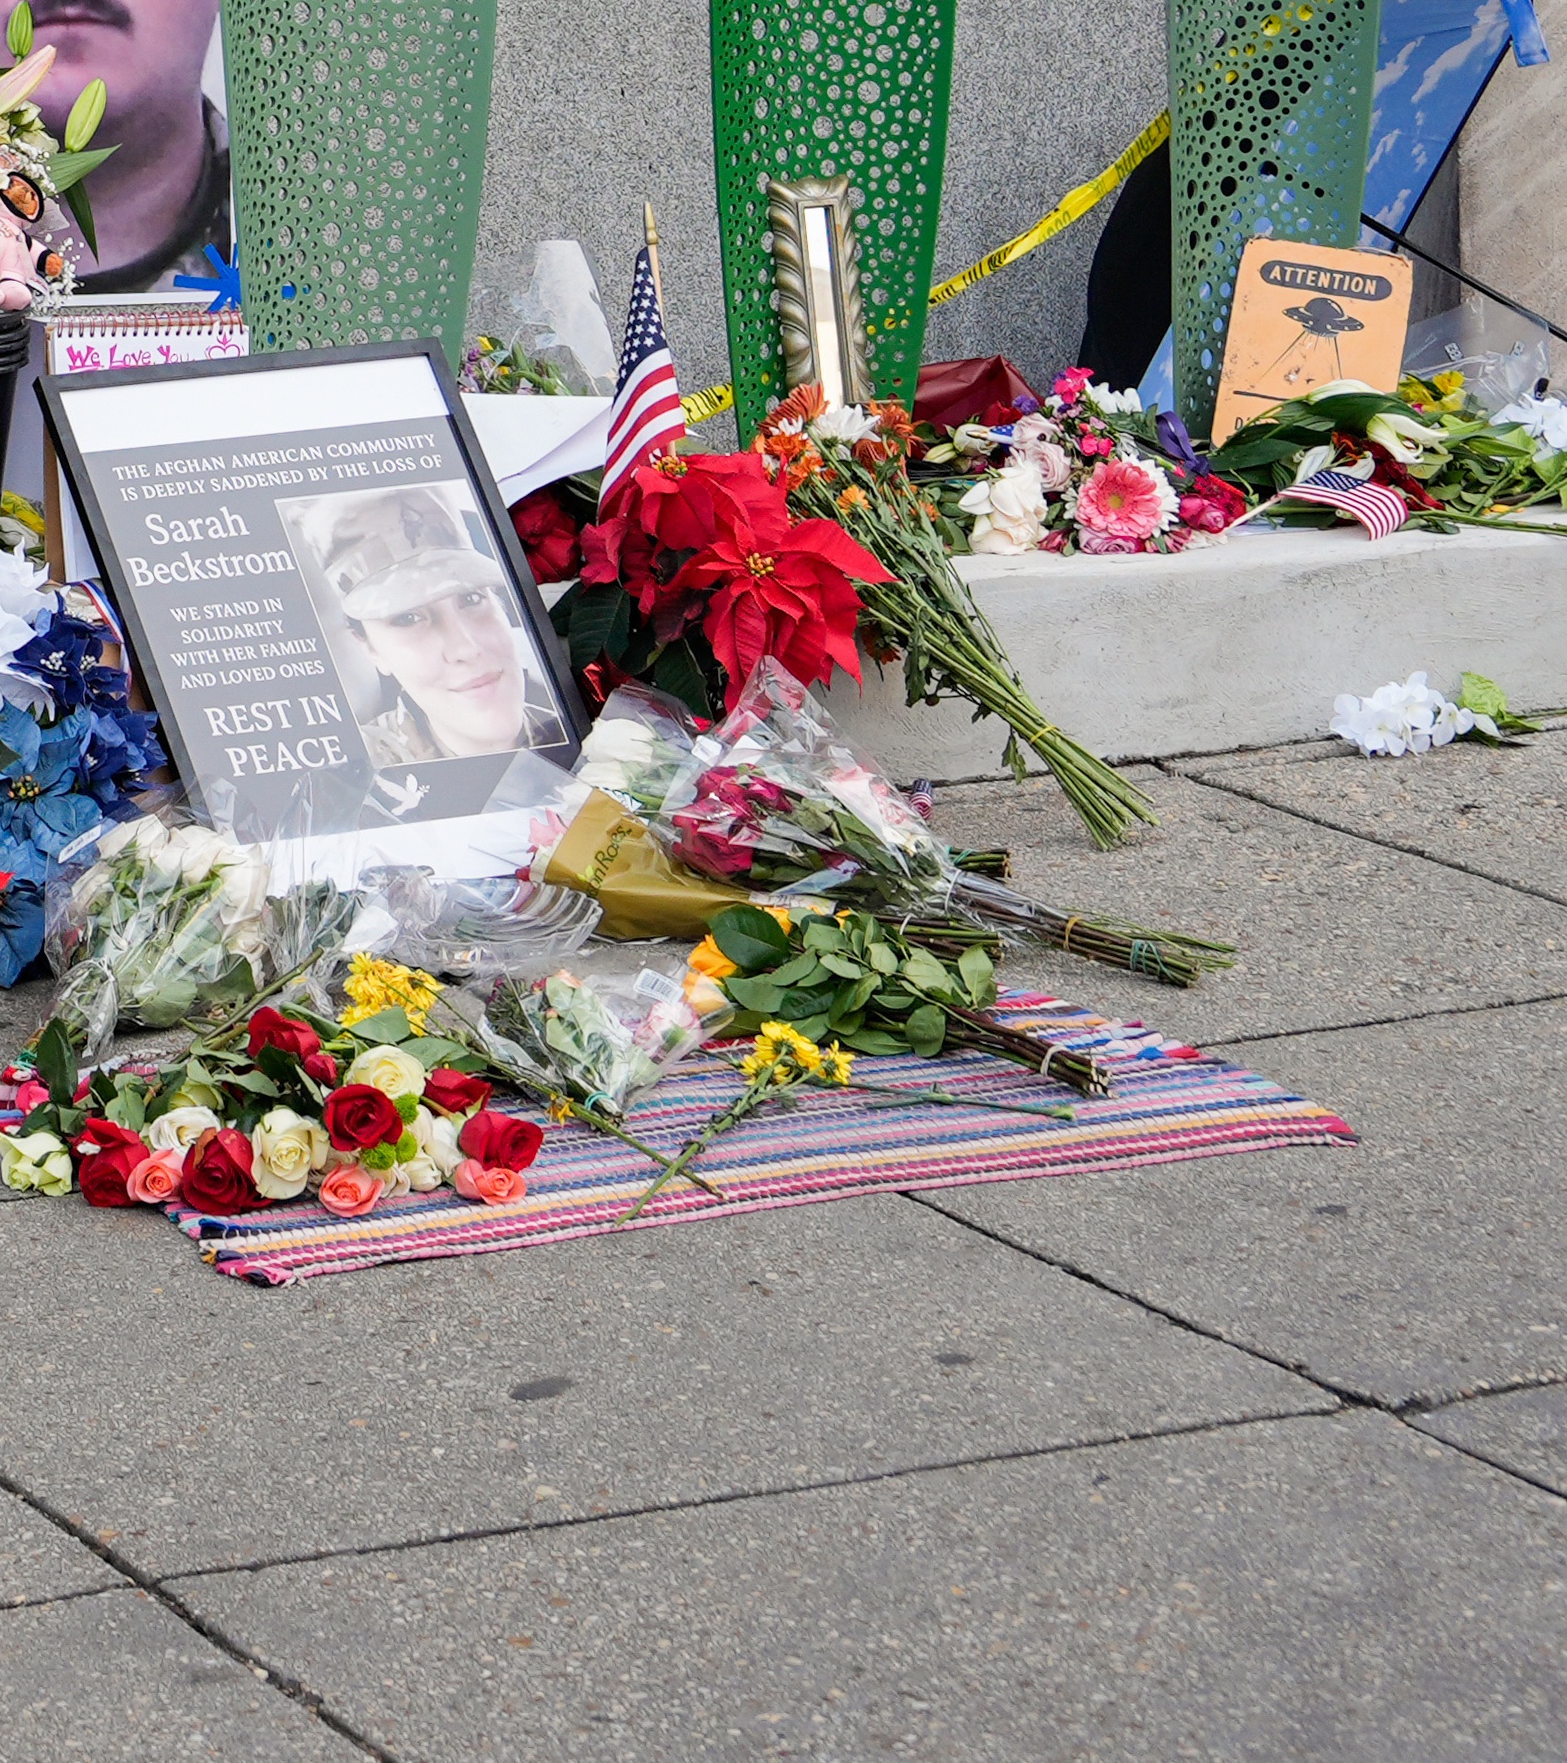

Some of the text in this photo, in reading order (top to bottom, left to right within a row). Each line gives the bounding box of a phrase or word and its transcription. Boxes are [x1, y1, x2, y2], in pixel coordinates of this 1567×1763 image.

[1269, 264, 1378, 296] ATTENTION
[66, 344, 102, 371] We
[109, 343, 153, 370] Love
[112, 434, 436, 481] THE AFGHAN AMERICAN COMMUNITY
[120, 453, 443, 502] IS DEEPLY SADDENED BY THE LOSS OF
[144, 505, 251, 545] Sarah
[126, 549, 296, 587] Beckstrom
[170, 597, 284, 622] WE STAND IN
[180, 619, 284, 644] SOLIDARITY
[170, 638, 318, 667] WITH HER FAMILY
[181, 659, 325, 689] AND LOVED ONES
[203, 694, 343, 737] REST IN
[225, 735, 349, 777] PEACE
